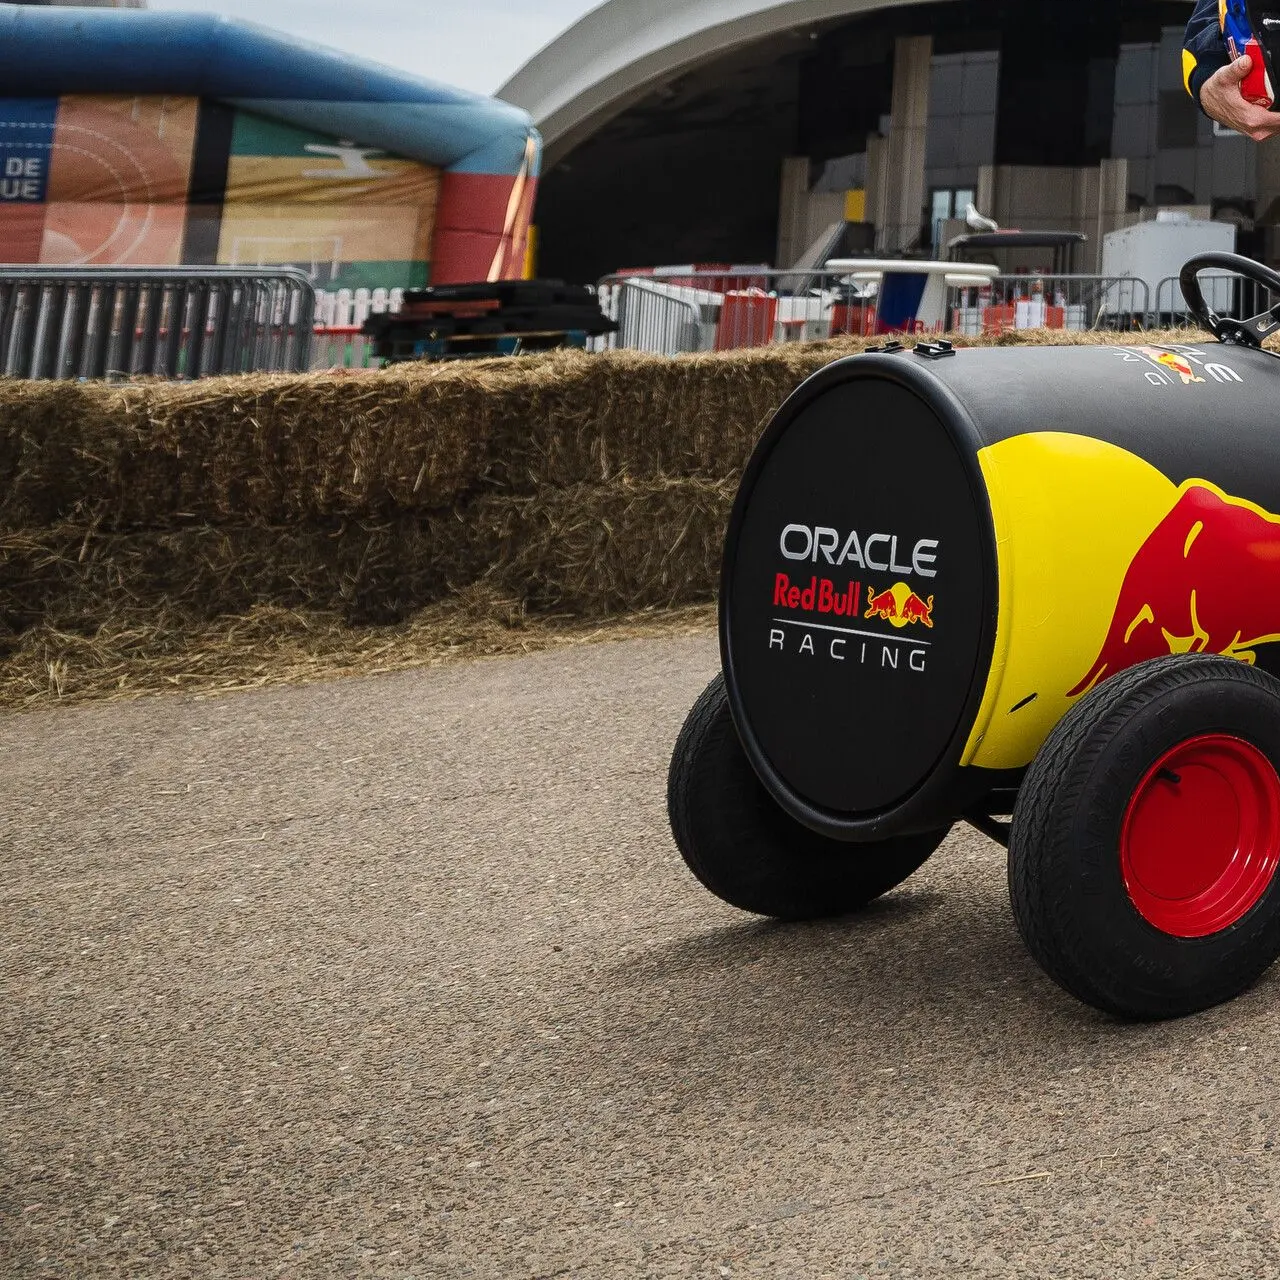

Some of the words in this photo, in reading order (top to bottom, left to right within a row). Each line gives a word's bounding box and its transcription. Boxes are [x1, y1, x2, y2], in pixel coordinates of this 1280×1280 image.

[5, 157, 41, 177] DE
[780, 524, 939, 577] ORACLE
[773, 573, 817, 610] Red
[817, 579, 861, 617] Bull
[769, 629, 926, 671] RACING
